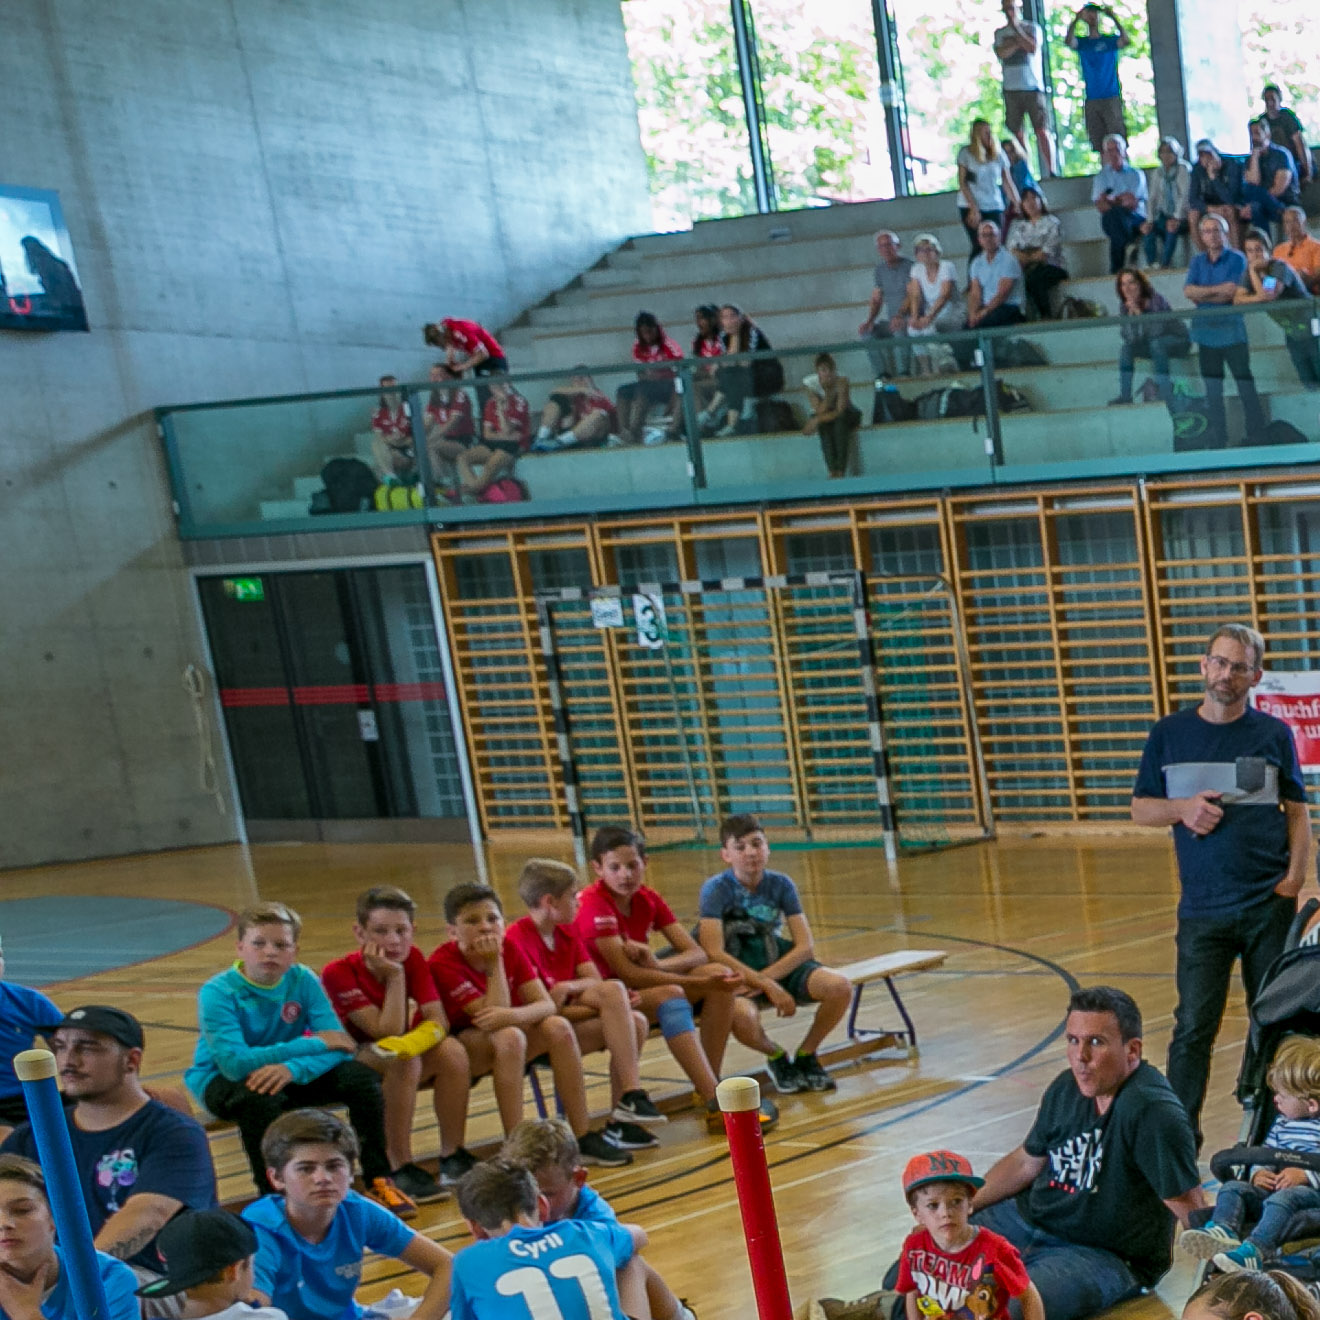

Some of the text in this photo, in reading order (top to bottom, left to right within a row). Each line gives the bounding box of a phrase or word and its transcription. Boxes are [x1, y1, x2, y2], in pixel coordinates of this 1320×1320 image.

[641, 605, 661, 642] 3
[927, 1153, 961, 1173] NY
[907, 1250, 972, 1286] TEAM
